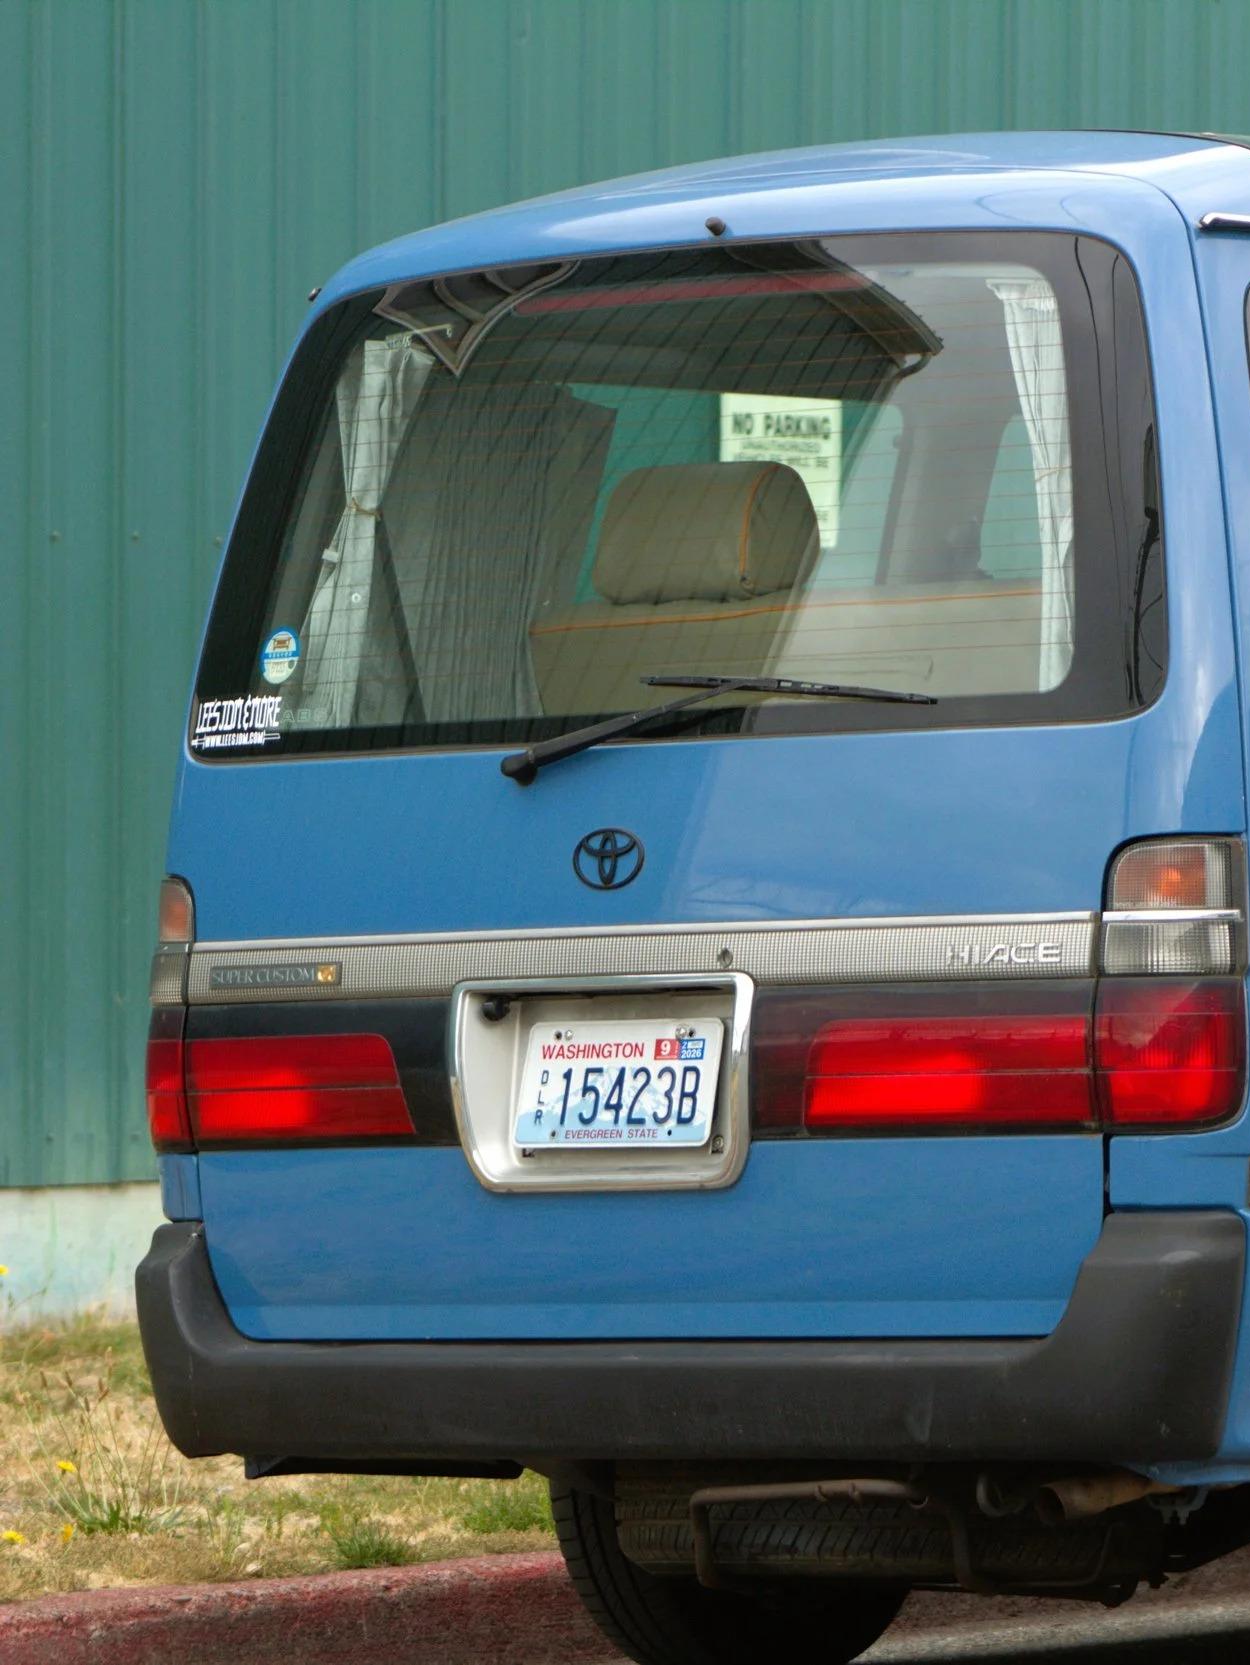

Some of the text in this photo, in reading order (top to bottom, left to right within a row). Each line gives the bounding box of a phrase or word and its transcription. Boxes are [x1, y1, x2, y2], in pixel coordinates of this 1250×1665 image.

[732, 413, 831, 439] NO PARKING
[945, 943, 1061, 965] HIACE
[212, 969, 253, 984] SUPER
[256, 966, 315, 982] CUSTOM
[541, 1043, 645, 1060] WASHINGTON
[660, 1039, 671, 1056] 9
[681, 1049, 702, 1058] 2026
[559, 1065, 701, 1126] 15423B
[564, 1128, 658, 1139] EVERGREEN STATE
